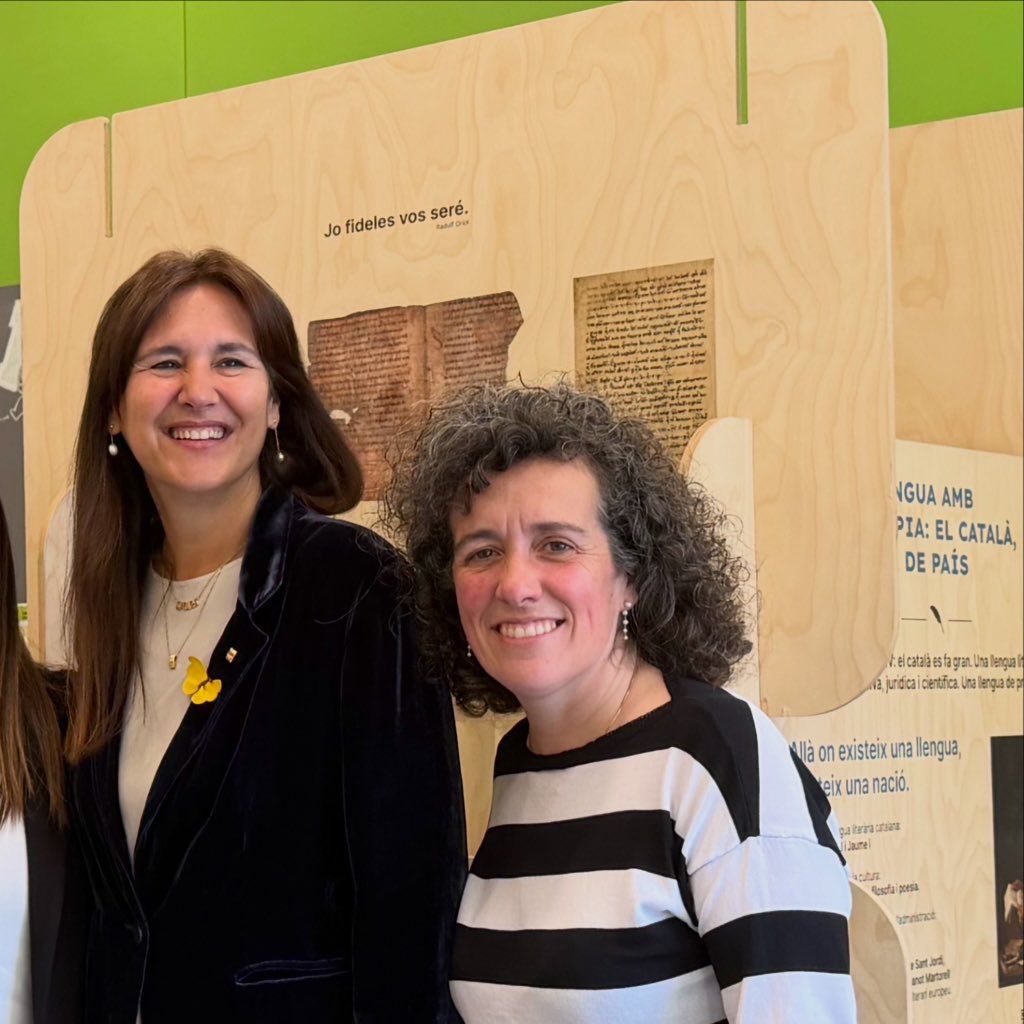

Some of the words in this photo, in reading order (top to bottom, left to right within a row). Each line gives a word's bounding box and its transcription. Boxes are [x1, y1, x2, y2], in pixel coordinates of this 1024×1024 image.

[324, 223, 341, 237] Jo
[345, 215, 395, 234] fideles
[400, 210, 426, 225] vos
[430, 200, 469, 220] seré.
[942, 485, 973, 509] AMB
[935, 519, 953, 541] EL
[958, 519, 1016, 551] CATALÀ,
[905, 551, 926, 573] DE
[932, 548, 969, 575] PAÍS
[898, 653, 906, 668] el
[907, 652, 931, 668] català
[933, 656, 942, 668] es
[943, 652, 952, 668] fa
[973, 653, 989, 668] Una
[990, 654, 1017, 671] llengua
[961, 676, 976, 690] Una
[978, 676, 1004, 692] llengua
[1006, 676, 1015, 690] de
[818, 744, 835, 762] on
[838, 738, 887, 761] existeix
[891, 741, 913, 759] una
[916, 736, 962, 762] llengua,
[846, 777, 869, 796] una
[872, 769, 910, 794] nació.
